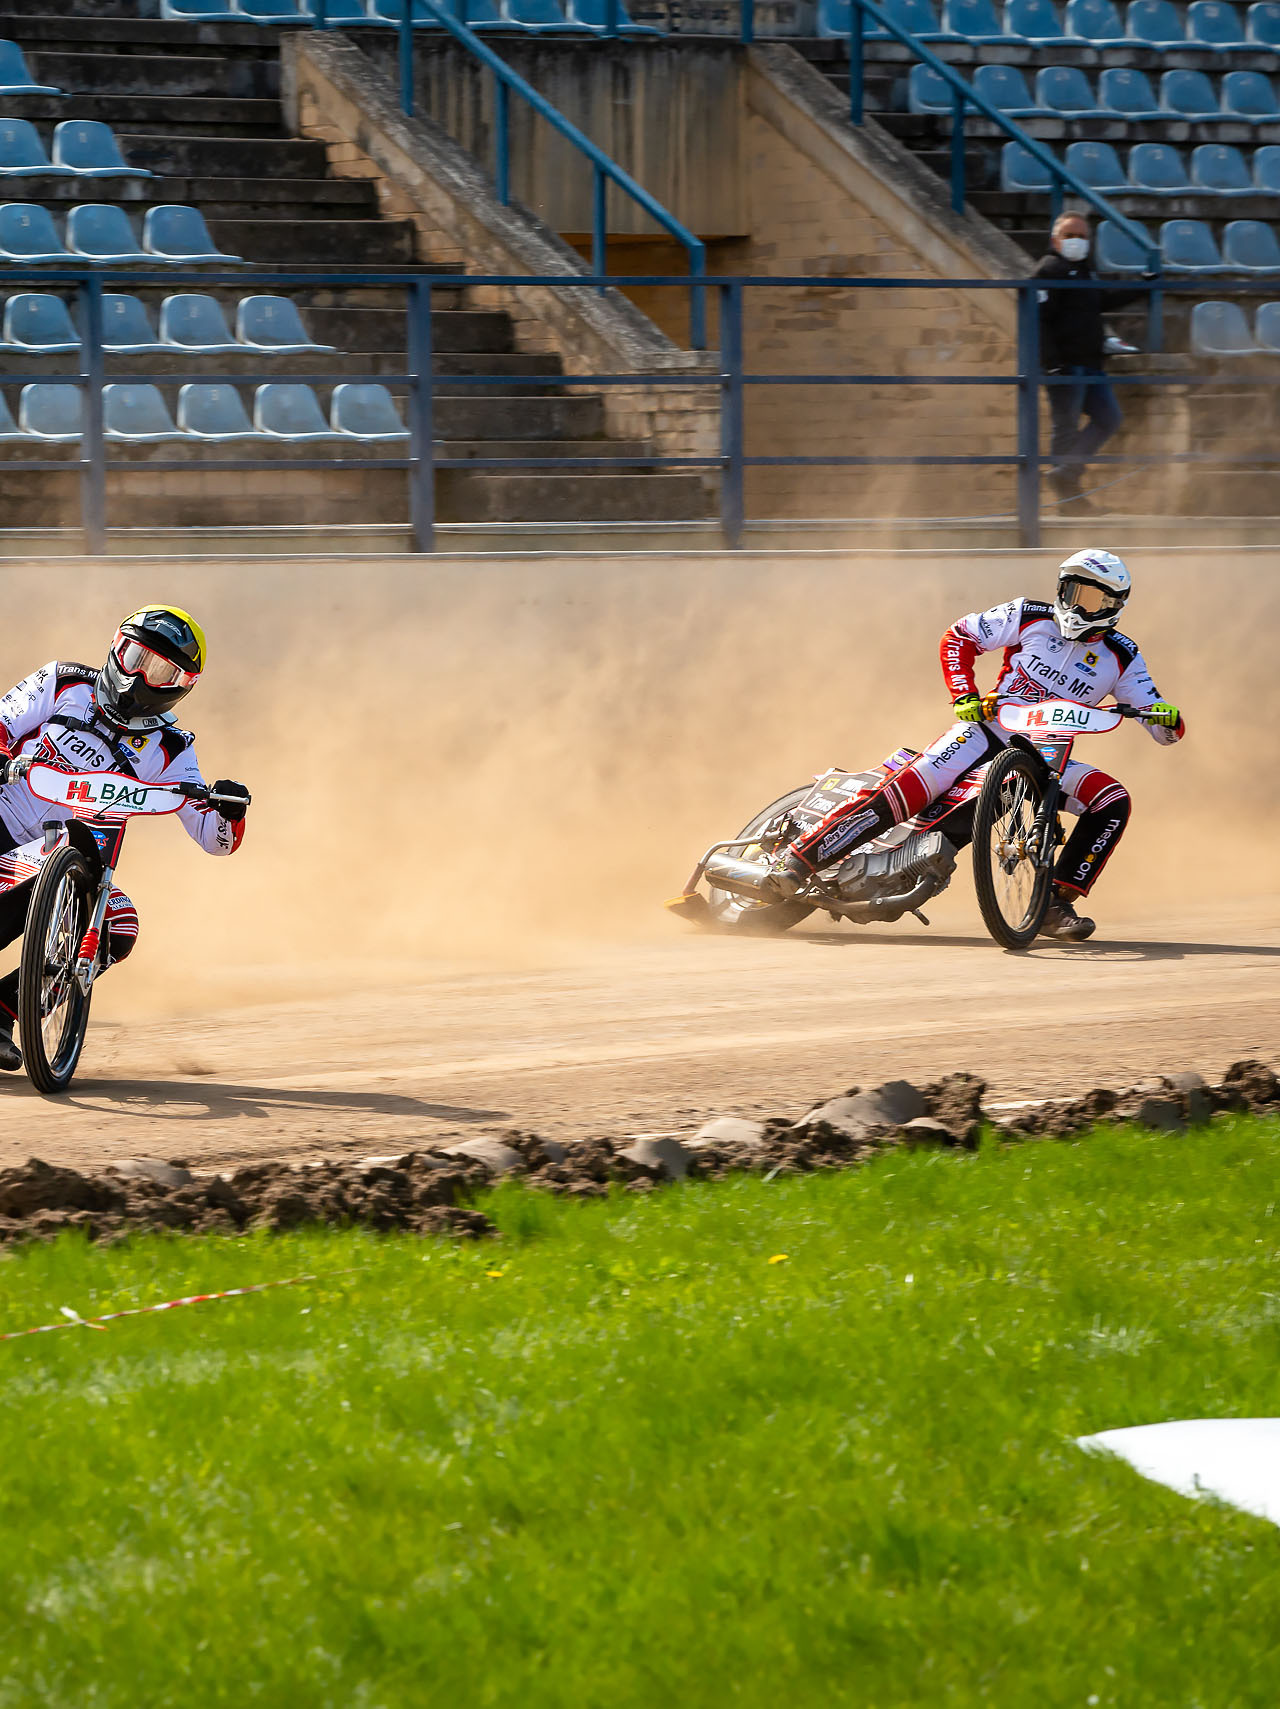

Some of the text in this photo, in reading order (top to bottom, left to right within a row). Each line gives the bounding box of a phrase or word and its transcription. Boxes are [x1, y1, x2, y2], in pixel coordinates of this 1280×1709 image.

[59, 664, 86, 676] Trans
[947, 639, 969, 692] Trans MF
[1026, 654, 1094, 699] Trans MF
[1051, 708, 1090, 725] BAU
[56, 728, 104, 768] Trans
[66, 780, 148, 805] HL BAU
[822, 830, 840, 848] Jörg
